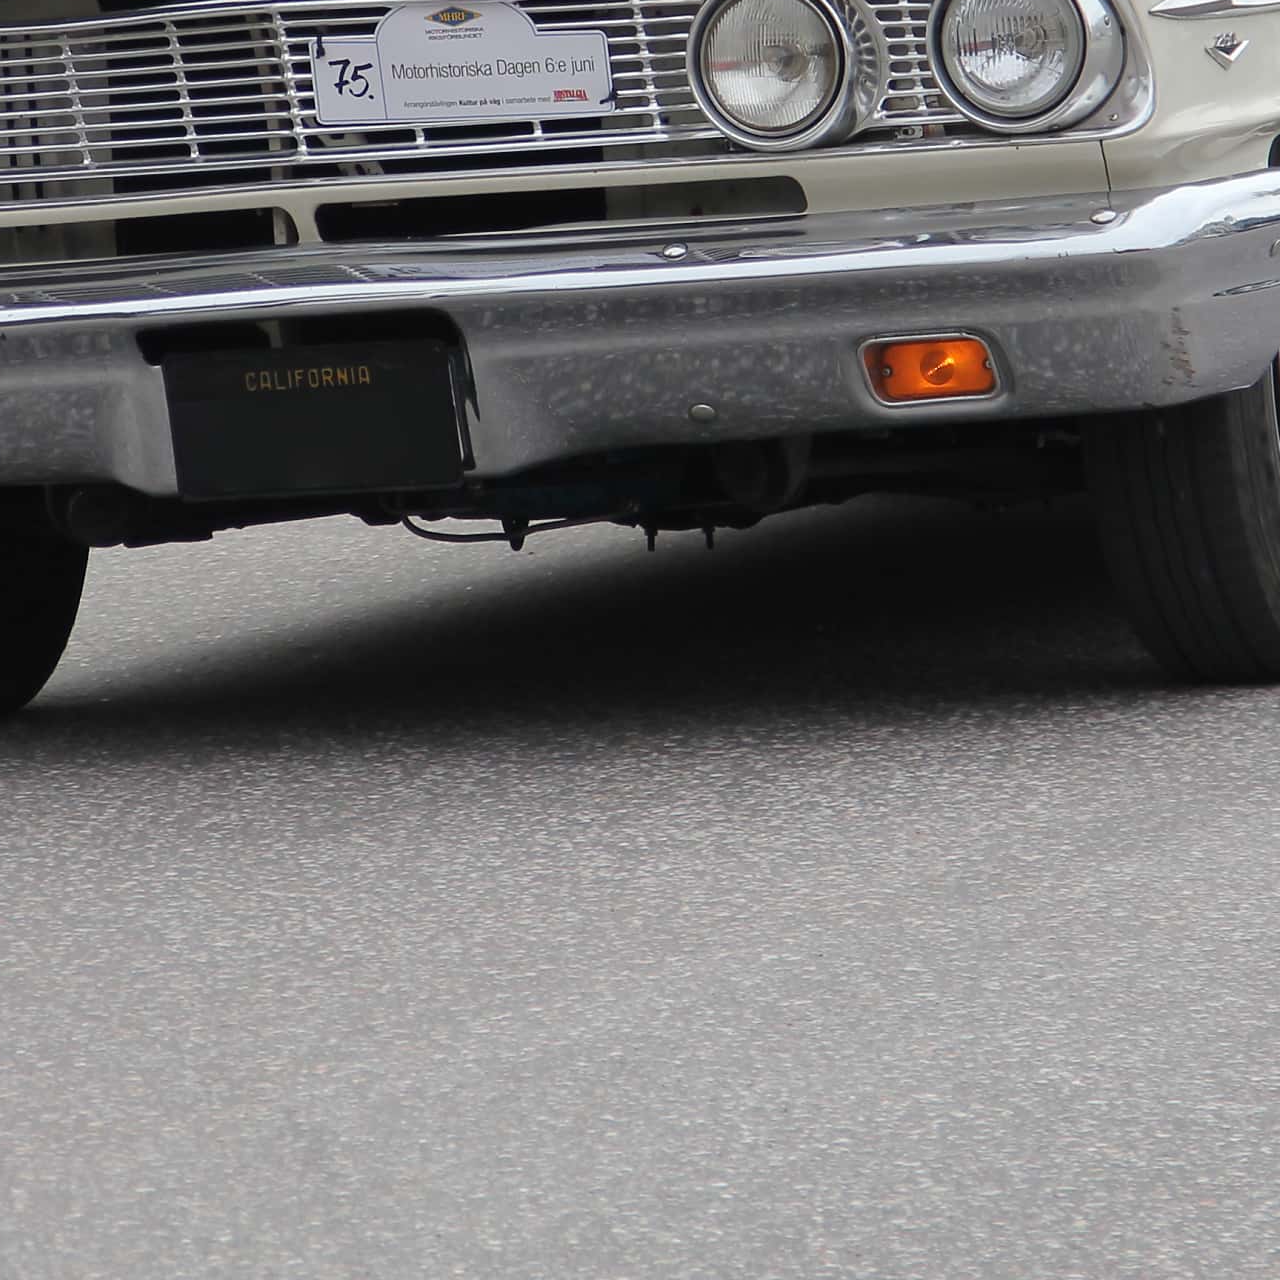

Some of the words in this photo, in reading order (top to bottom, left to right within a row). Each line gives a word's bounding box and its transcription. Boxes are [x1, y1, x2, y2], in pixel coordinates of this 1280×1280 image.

[391, 60, 493, 80] Motorhistoriska
[496, 58, 541, 78] Dagen
[545, 56, 567, 73] 6:e
[570, 55, 595, 76] juni
[245, 365, 371, 392] CALIFORNIA
